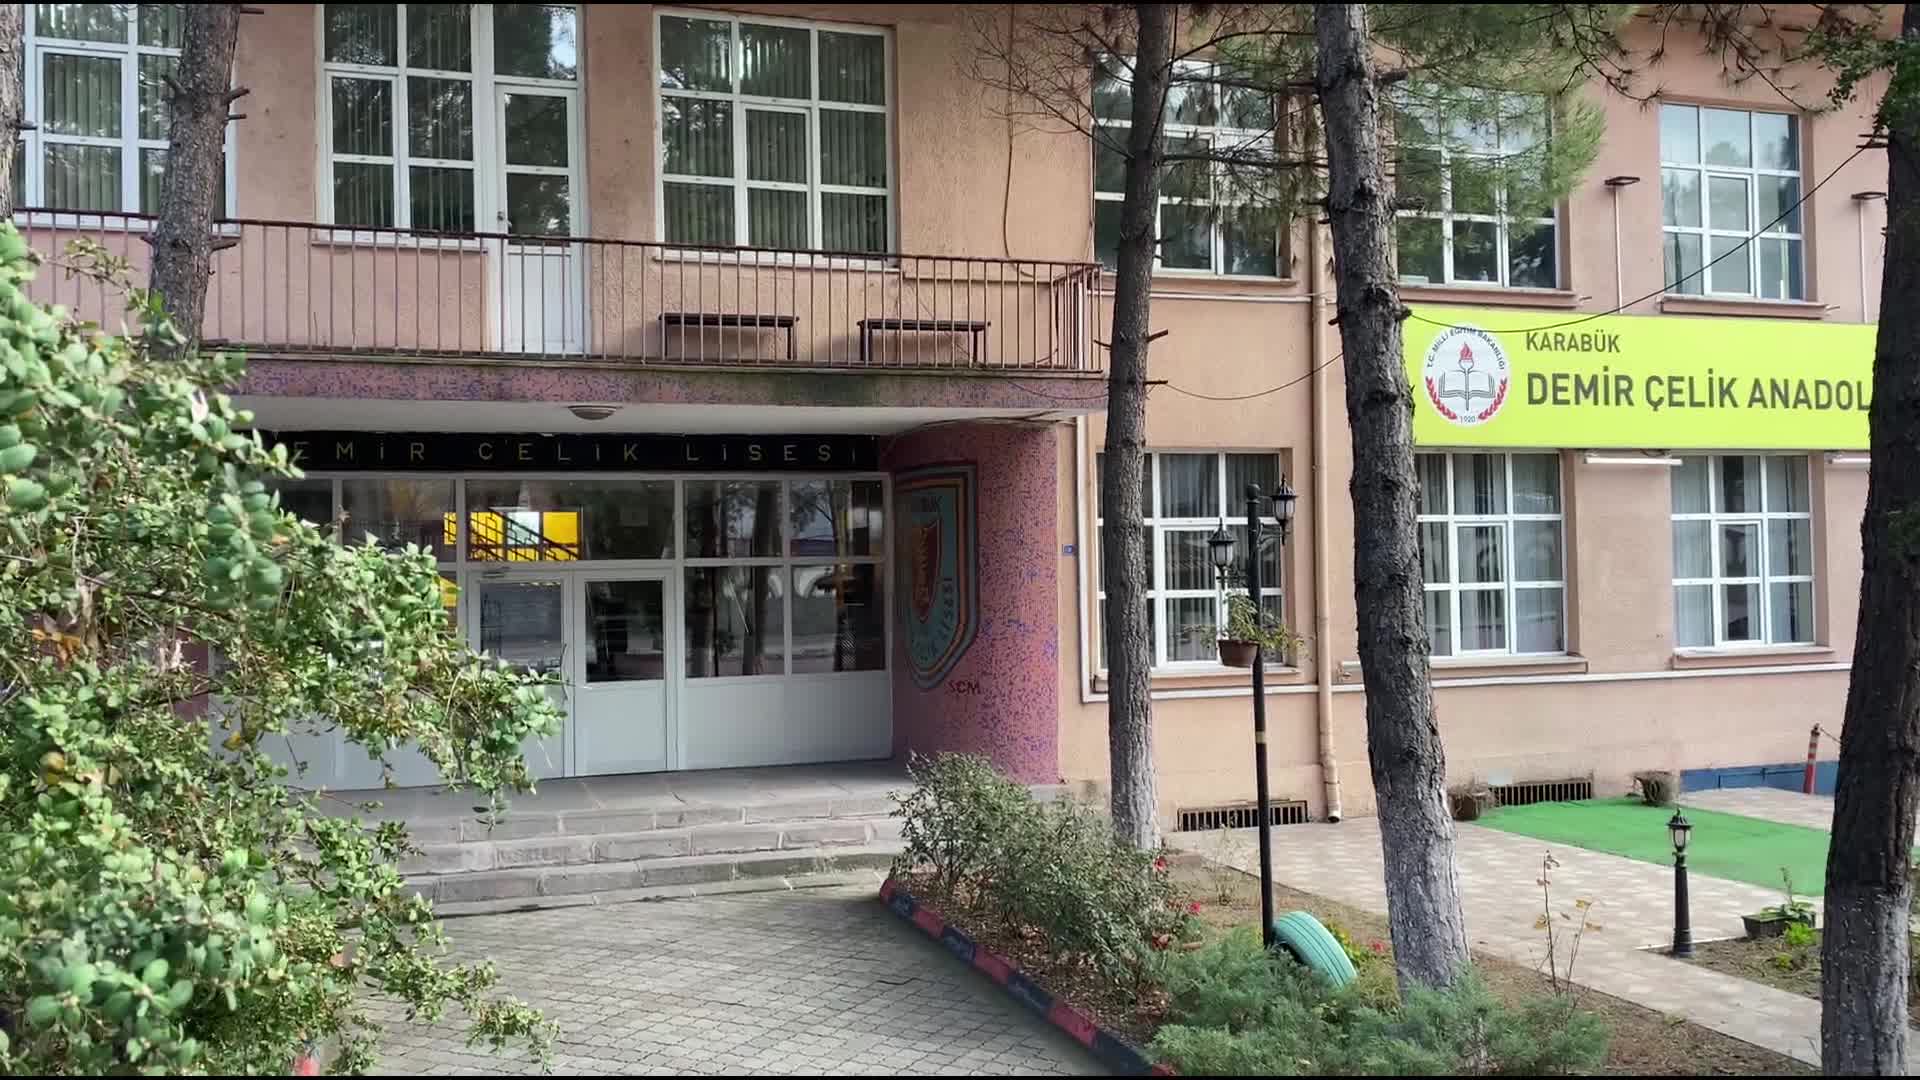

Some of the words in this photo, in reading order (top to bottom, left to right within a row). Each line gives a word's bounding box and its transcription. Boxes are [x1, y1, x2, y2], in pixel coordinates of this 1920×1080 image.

[1526, 329, 1621, 353] KARABÜK
[1527, 366, 1634, 406] DEMİR
[1645, 368, 1738, 411] ÇELİK
[1747, 377, 1872, 411] ANADOL
[294, 440, 426, 462] EMİR
